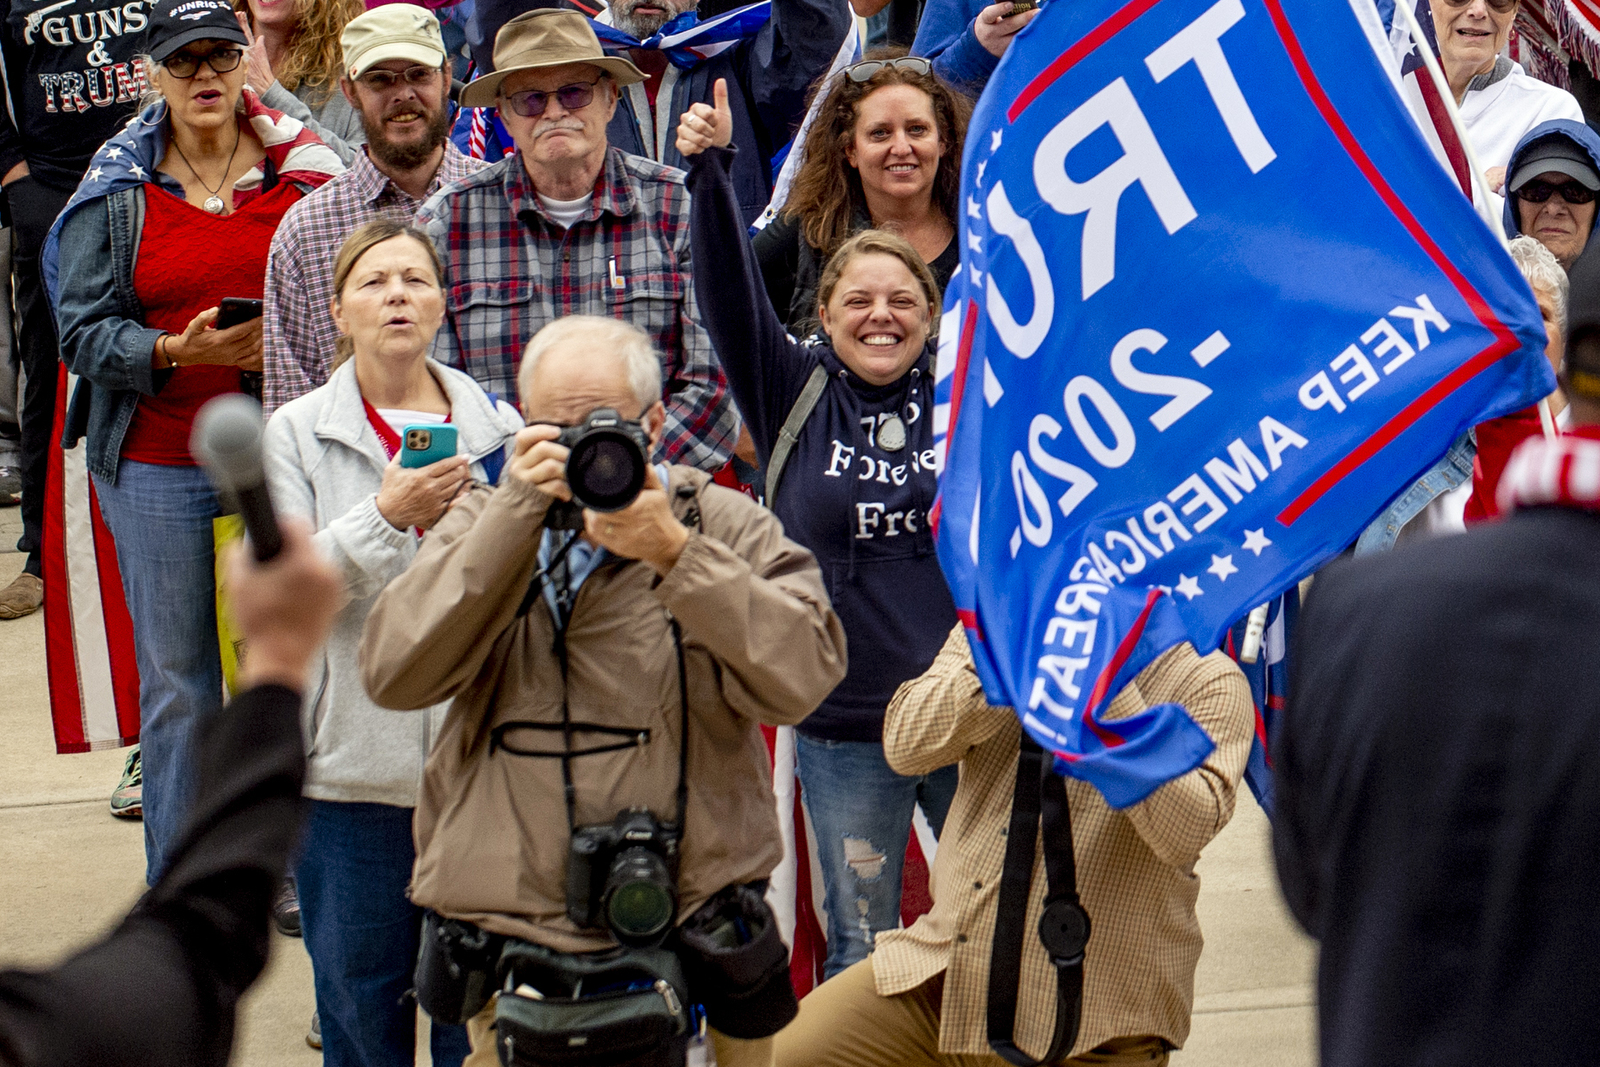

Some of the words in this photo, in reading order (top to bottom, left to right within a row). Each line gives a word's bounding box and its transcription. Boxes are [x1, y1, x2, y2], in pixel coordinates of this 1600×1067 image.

[42, 1, 149, 46] GUNS
[86, 40, 113, 67] &
[38, 58, 151, 114] TRUM
[590, 417, 618, 427] Canon
[823, 439, 938, 486] Foree
